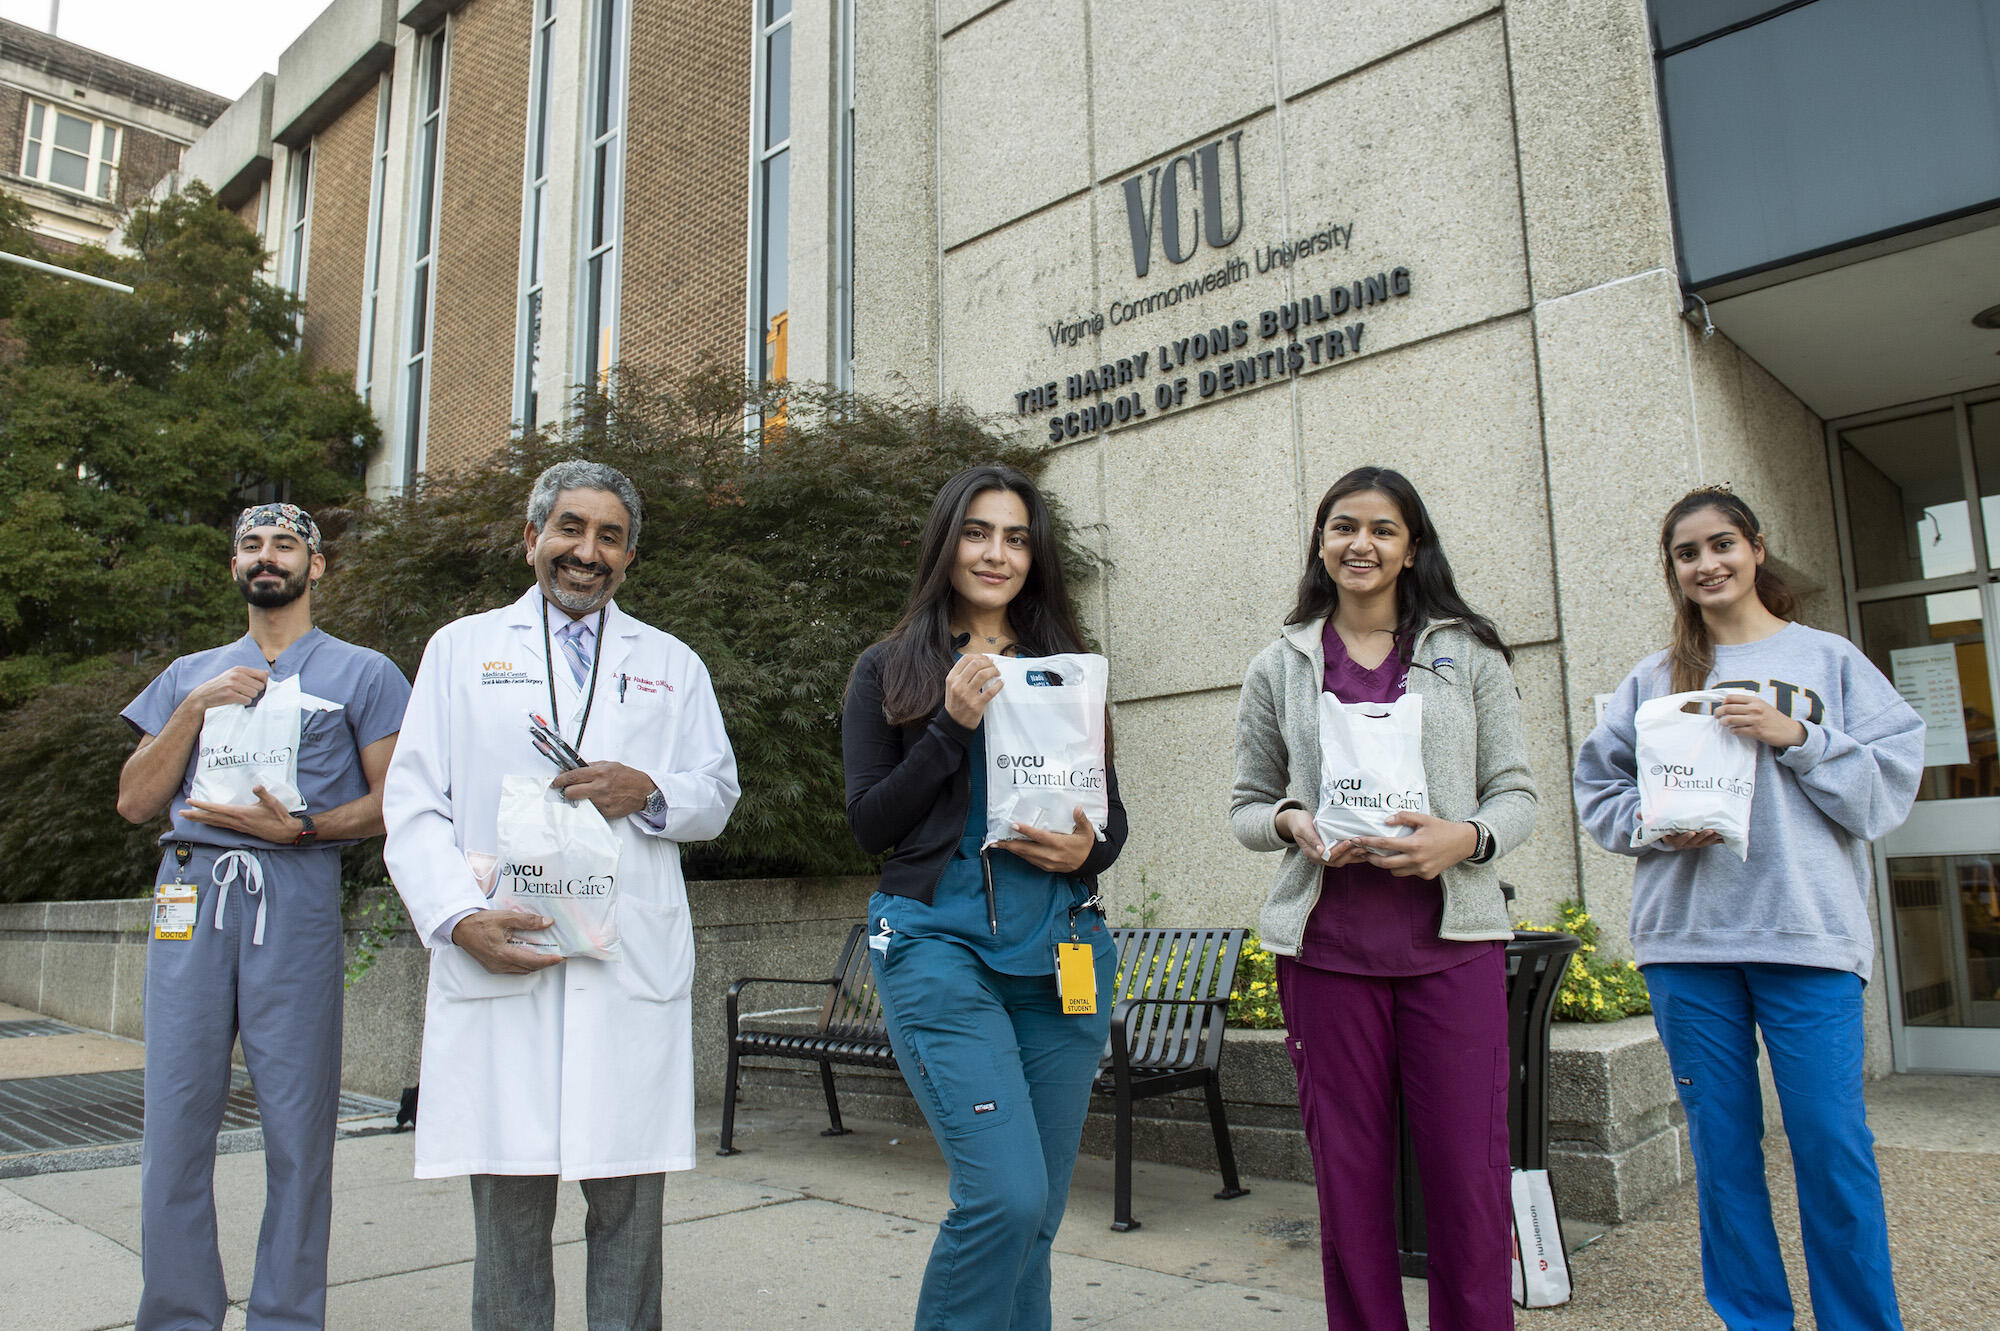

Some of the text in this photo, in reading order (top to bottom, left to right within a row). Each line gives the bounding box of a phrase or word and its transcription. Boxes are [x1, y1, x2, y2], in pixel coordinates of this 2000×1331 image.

[1121, 130, 1243, 277] VCU
[1049, 222, 1353, 347] Virginia Commonwealth University
[1015, 266, 1410, 416] THE HARRY LYONS BUILDING
[1049, 322, 1364, 442] SCHOOL OF DENTISTRY
[482, 661, 512, 671] VCU
[207, 752, 249, 768] Dental
[252, 751, 287, 764] Care
[1011, 755, 1045, 768] VCU
[1012, 769, 1102, 789] Dental Care
[1664, 765, 1694, 776] VCU
[1333, 779, 1362, 790] VCU
[1664, 774, 1713, 789] Dental
[1717, 777, 1751, 797] Care
[1330, 791, 1421, 810] Dental Care
[511, 864, 543, 876] VCU
[513, 877, 606, 896] Dental Care
[1530, 1205, 1545, 1256] lululemon
